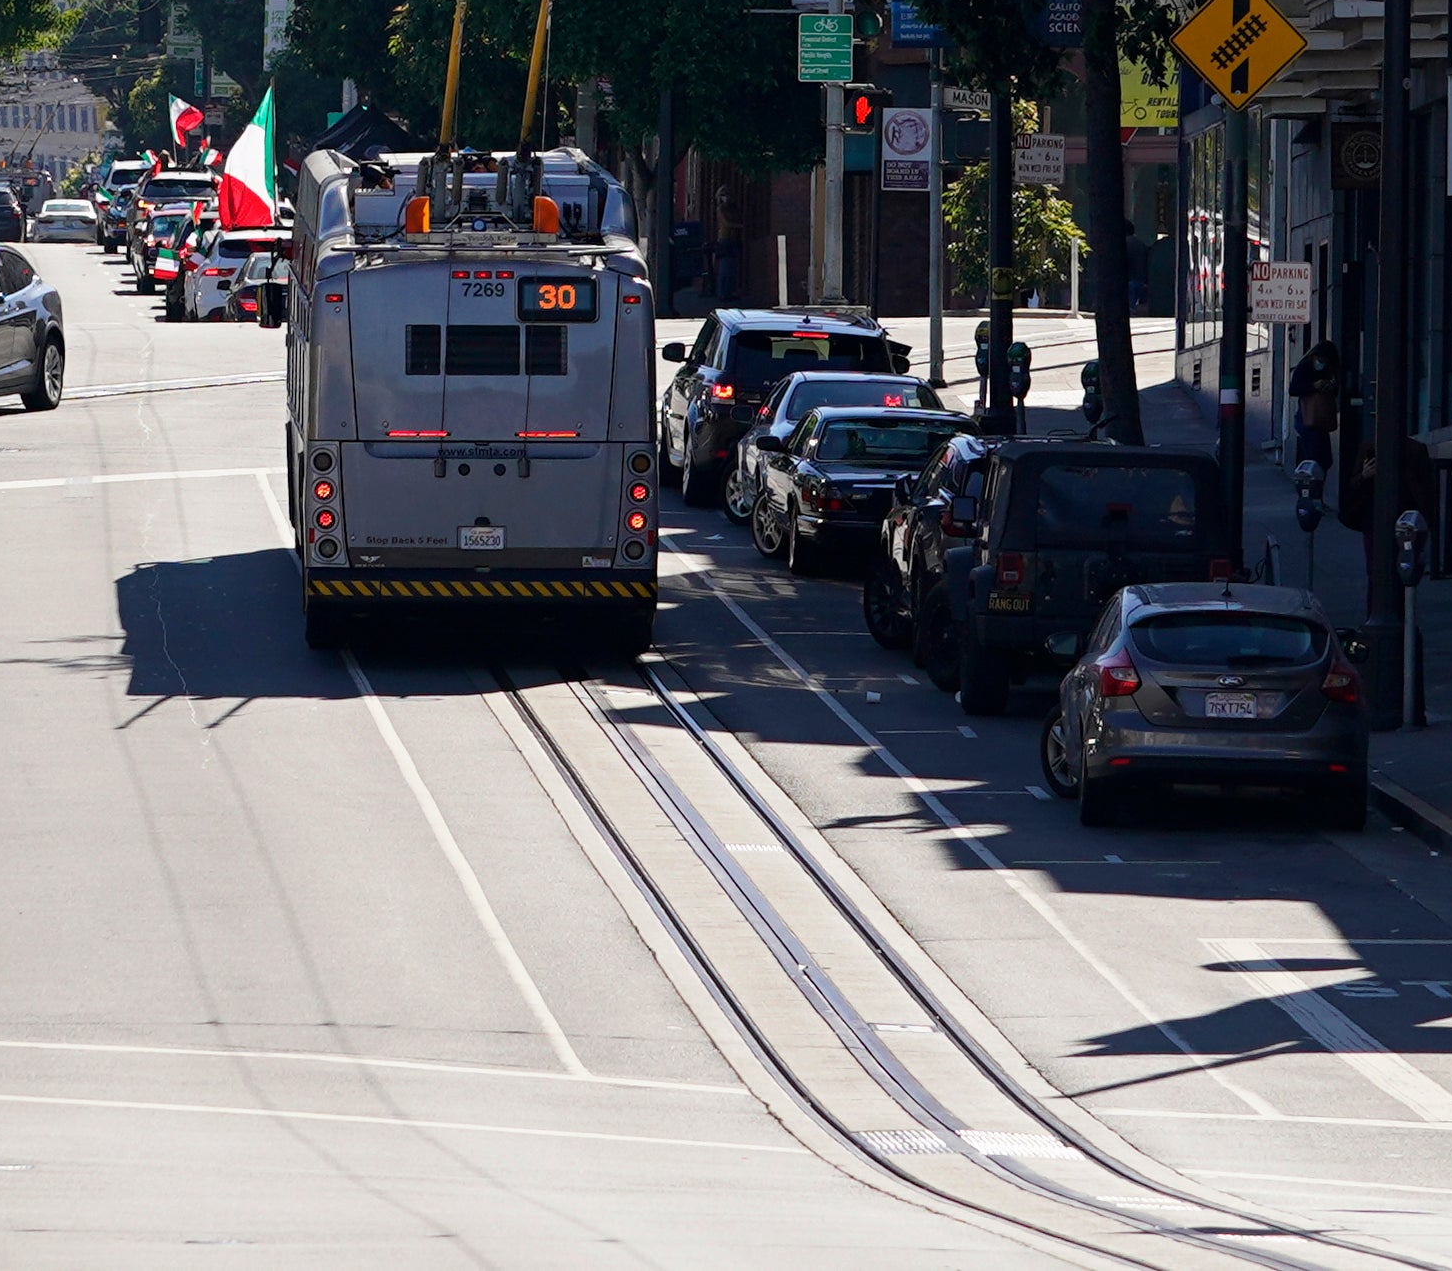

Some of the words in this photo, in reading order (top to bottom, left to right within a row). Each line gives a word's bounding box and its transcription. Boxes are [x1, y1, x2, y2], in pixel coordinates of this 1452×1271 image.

[952, 91, 988, 106] MASON
[1018, 134, 1031, 148] NO
[1032, 138, 1063, 149] PARKING
[1253, 263, 1270, 280] NO
[1271, 266, 1309, 281] PARKING
[462, 282, 505, 298] 7269
[538, 284, 576, 310] 30
[1271, 299, 1283, 310] WED
[1285, 299, 1295, 310] FRI
[1296, 300, 1307, 310] SAT
[438, 447, 526, 458] www.sfmta.com
[366, 536, 388, 545] Stop
